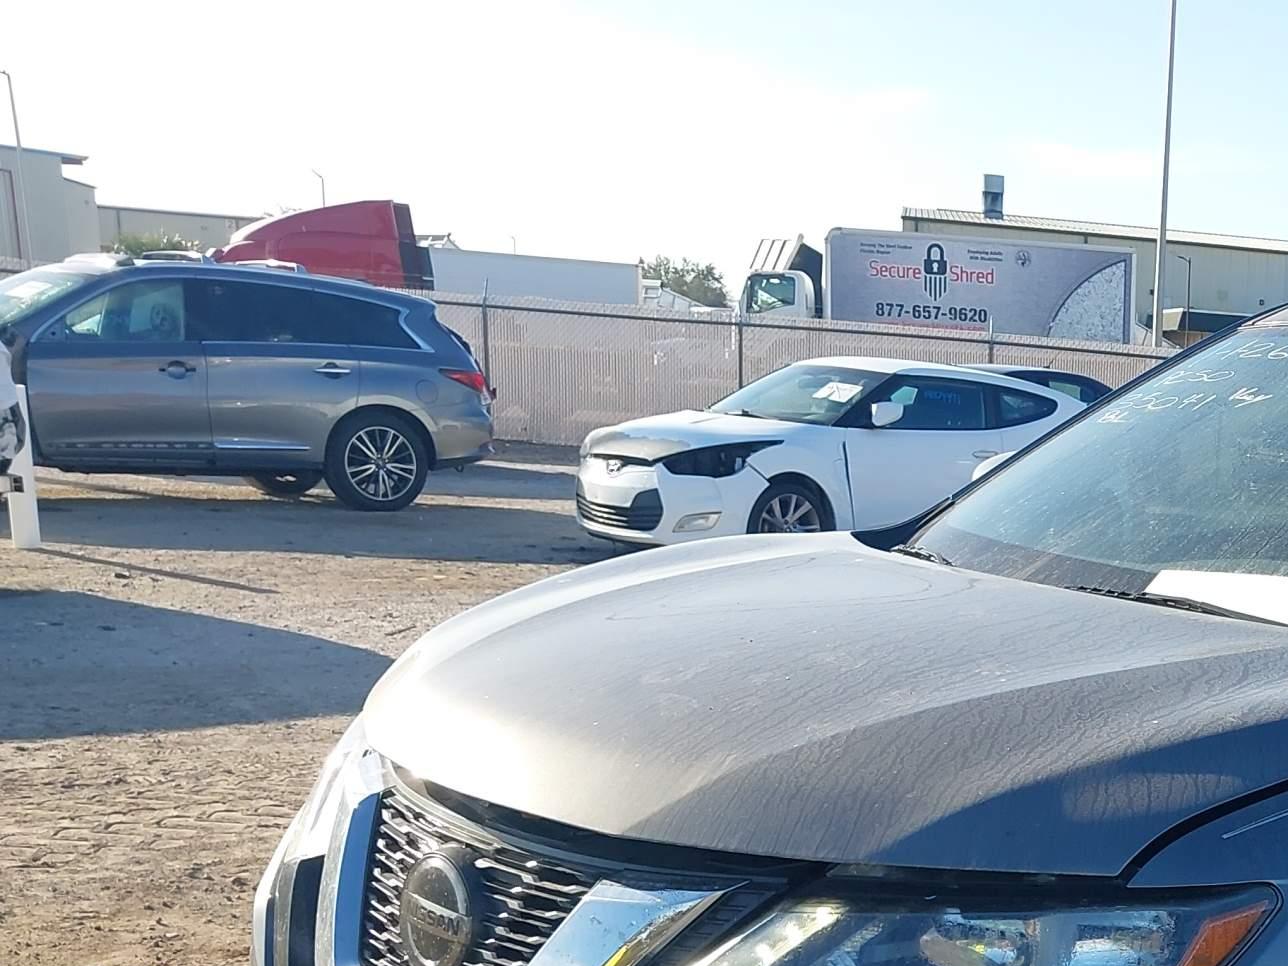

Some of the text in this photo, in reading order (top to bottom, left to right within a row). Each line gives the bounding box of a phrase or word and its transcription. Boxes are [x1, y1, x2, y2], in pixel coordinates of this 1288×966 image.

[869, 260, 994, 285] Secure Shred
[875, 302, 988, 323] 877-657-9620
